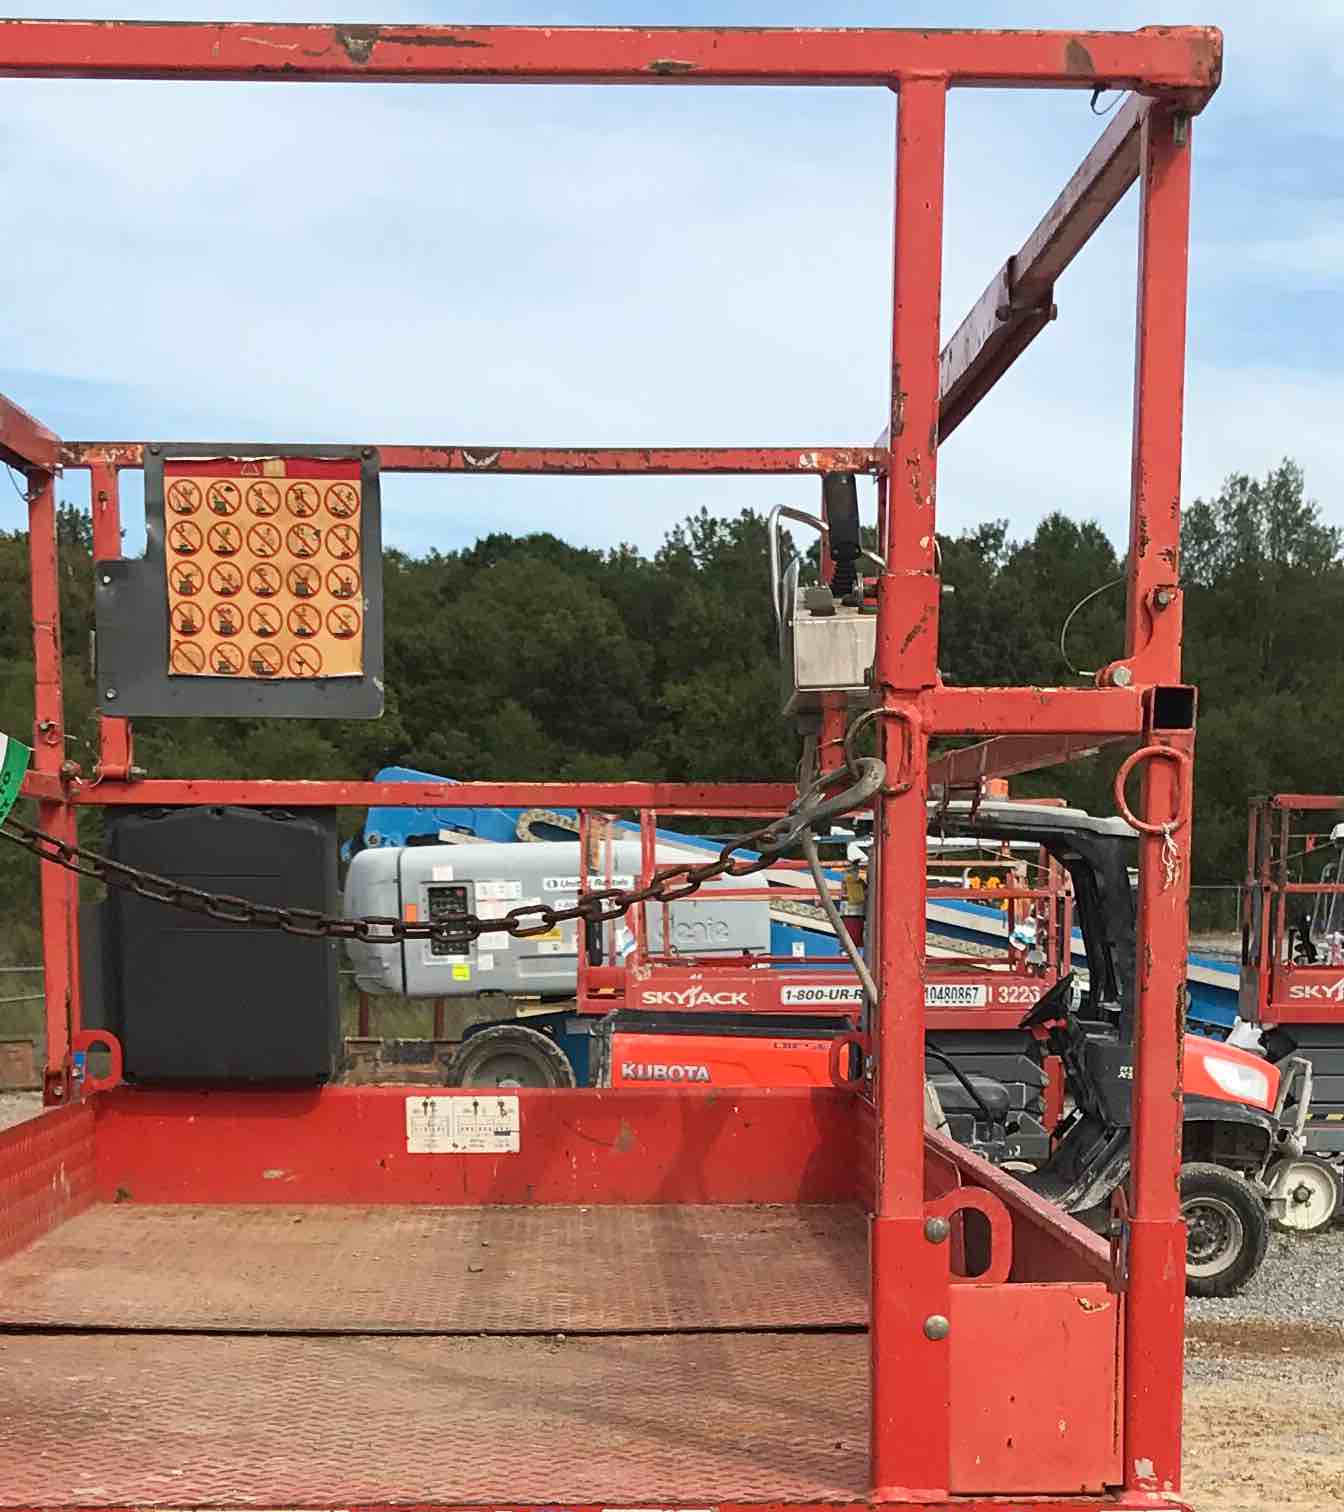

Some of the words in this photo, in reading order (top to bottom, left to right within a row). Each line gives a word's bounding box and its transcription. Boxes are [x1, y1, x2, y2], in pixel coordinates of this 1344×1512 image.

[641, 985, 750, 1008] SKYJACK
[998, 985, 1041, 1003] 3226
[621, 1063, 712, 1082] KUBOTA
